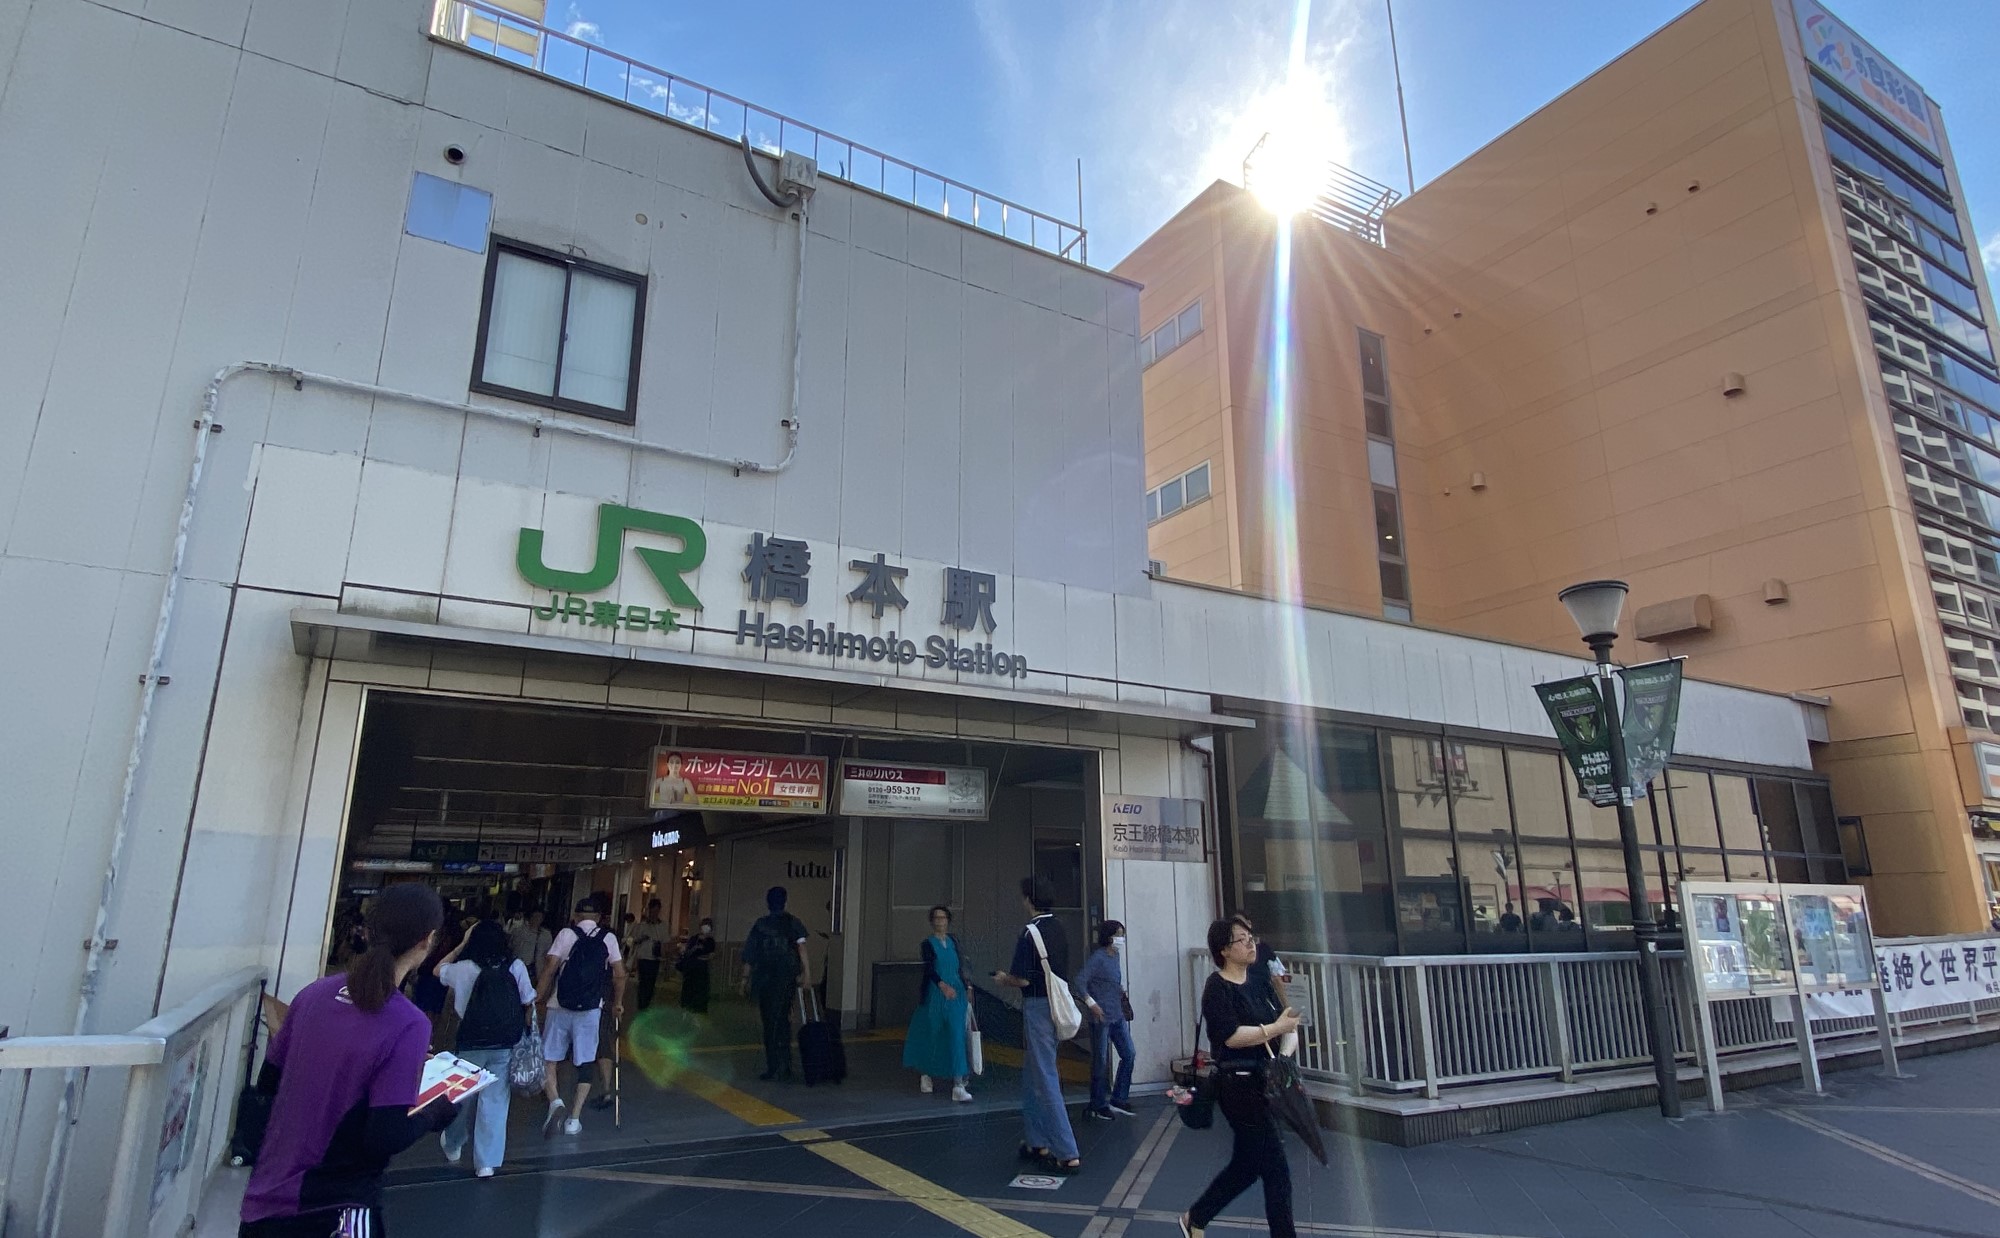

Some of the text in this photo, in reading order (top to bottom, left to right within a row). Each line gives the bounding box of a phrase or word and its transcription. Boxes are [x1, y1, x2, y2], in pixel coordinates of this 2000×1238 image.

[516, 503, 707, 610] JR
[740, 531, 998, 635] 橋本駅
[533, 594, 682, 635] JR東日本
[736, 610, 1028, 679] Hashimoto Station
[850, 766, 903, 780] 三井のリハウス
[780, 784, 814, 795] 女性専用
[1113, 803, 1142, 815] KEIO
[1112, 823, 1200, 845] 京王線橋本駅
